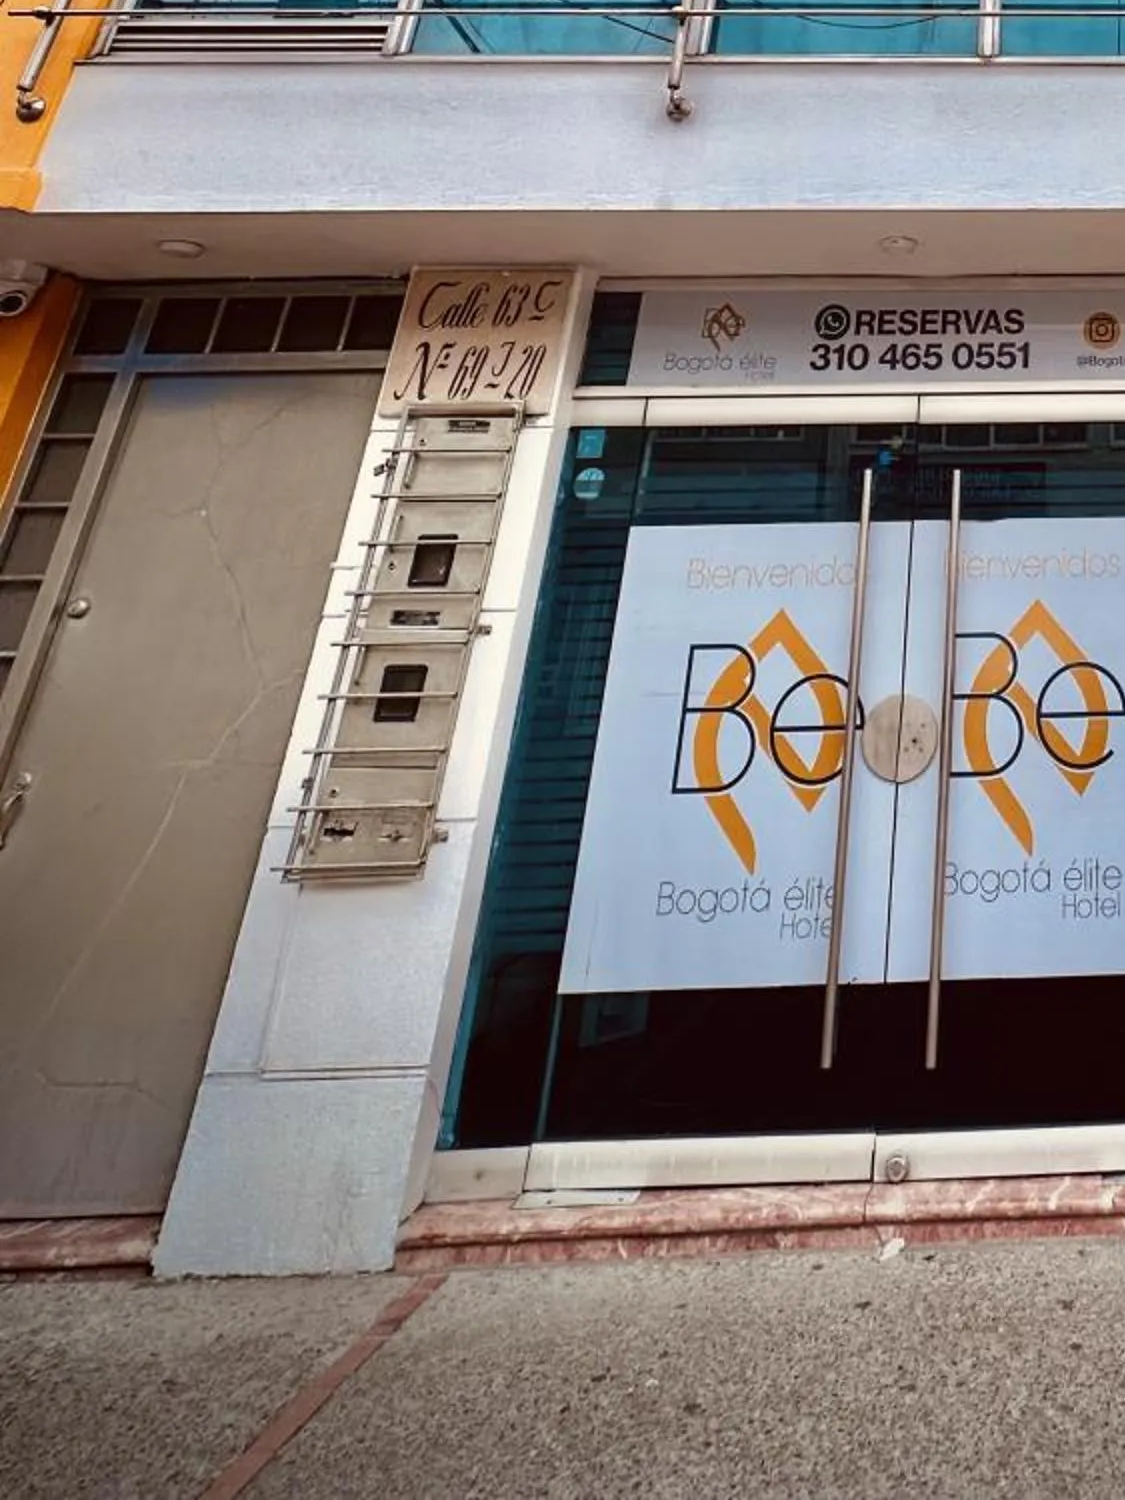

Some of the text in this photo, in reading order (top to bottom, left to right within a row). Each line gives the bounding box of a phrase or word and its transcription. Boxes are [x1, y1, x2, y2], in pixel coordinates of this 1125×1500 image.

[417, 281, 491, 329] Calle
[853, 308, 1025, 336] RESERVAS
[809, 341, 1031, 371] 310 465 0551
[687, 556, 857, 590] Bienvenido
[1063, 857, 1123, 891] élite
[656, 878, 771, 922] Bogotá
[1062, 890, 1121, 919] Hotel
